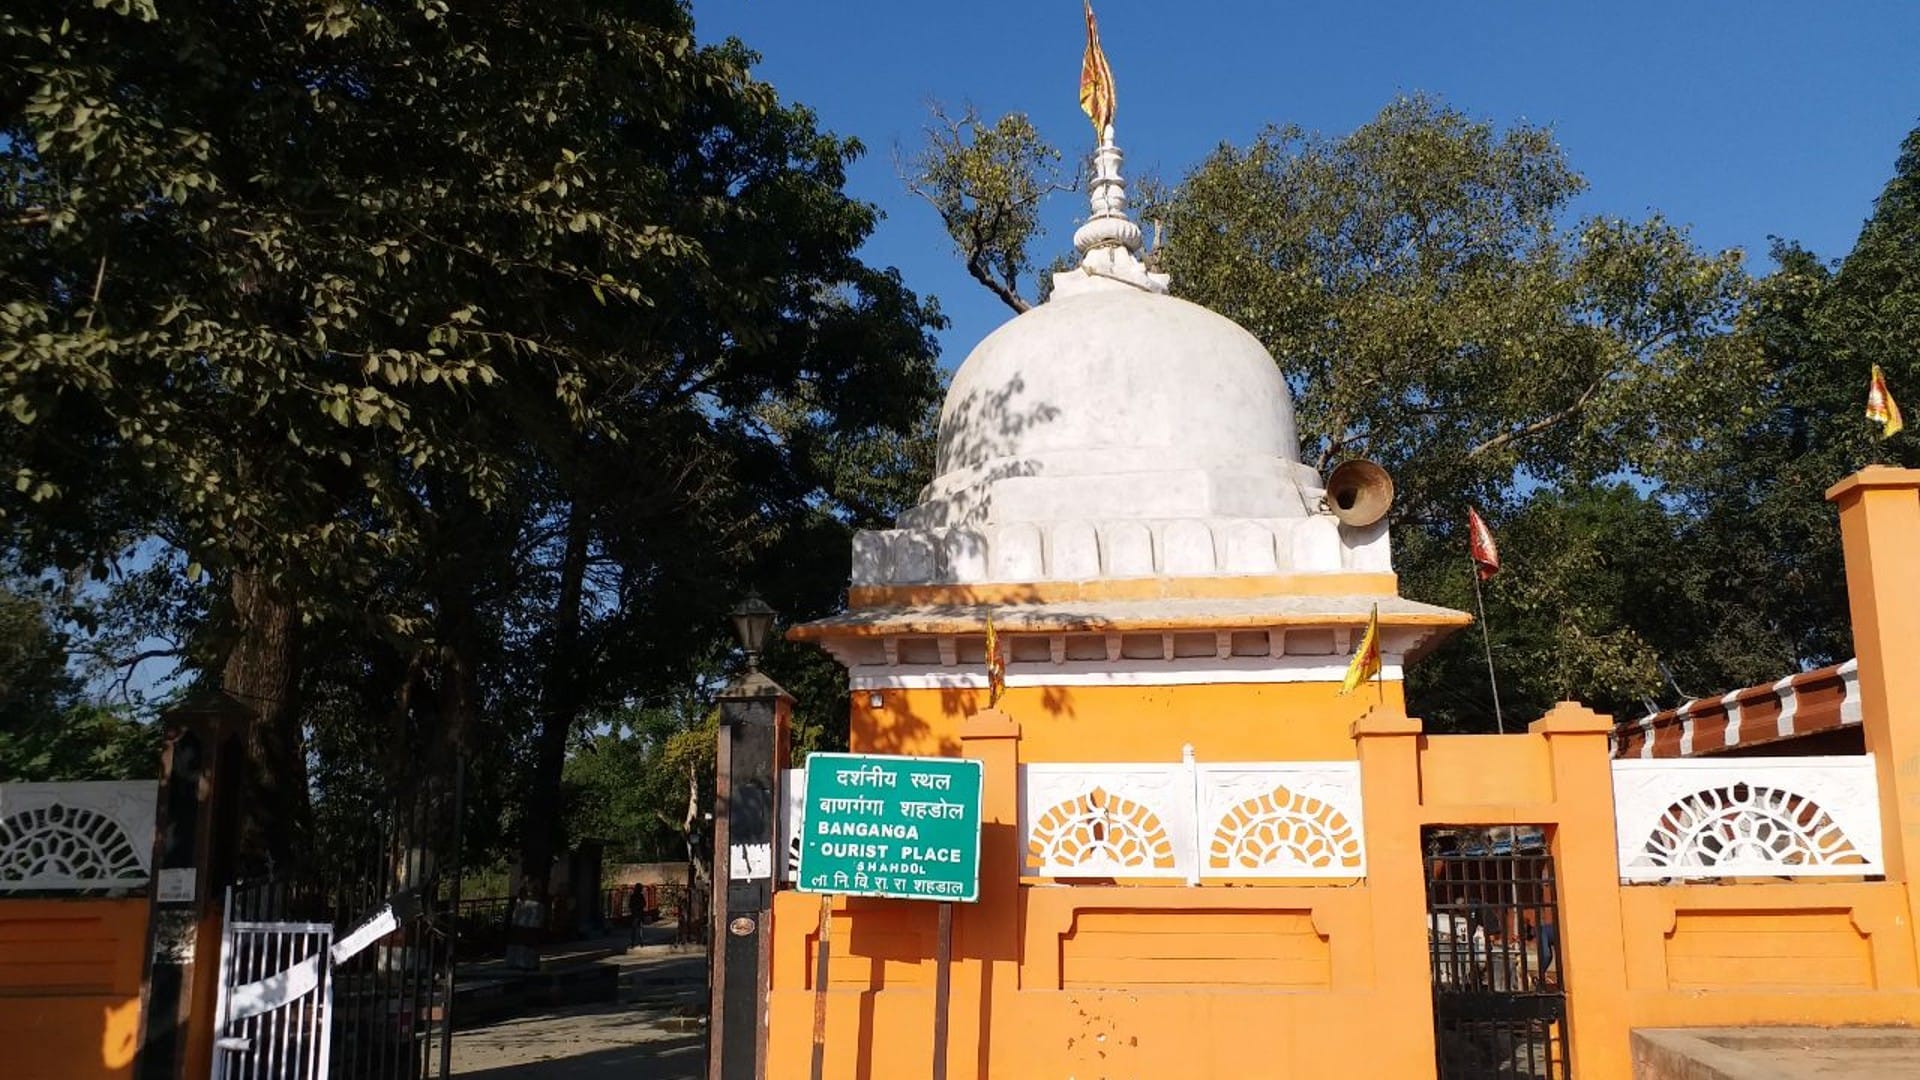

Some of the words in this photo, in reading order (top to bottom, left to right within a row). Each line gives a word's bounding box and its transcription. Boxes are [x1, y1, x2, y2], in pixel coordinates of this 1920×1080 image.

[836, 764, 898, 789] दर्शनीय
[910, 772, 952, 790] स्थल
[818, 795, 885, 816] बाणगंगा
[899, 797, 965, 820] शहडोल
[817, 820, 919, 840] BANGANGA
[810, 841, 889, 859] OURIST
[901, 846, 961, 863] PLACE
[856, 861, 927, 875] SHAHDOL
